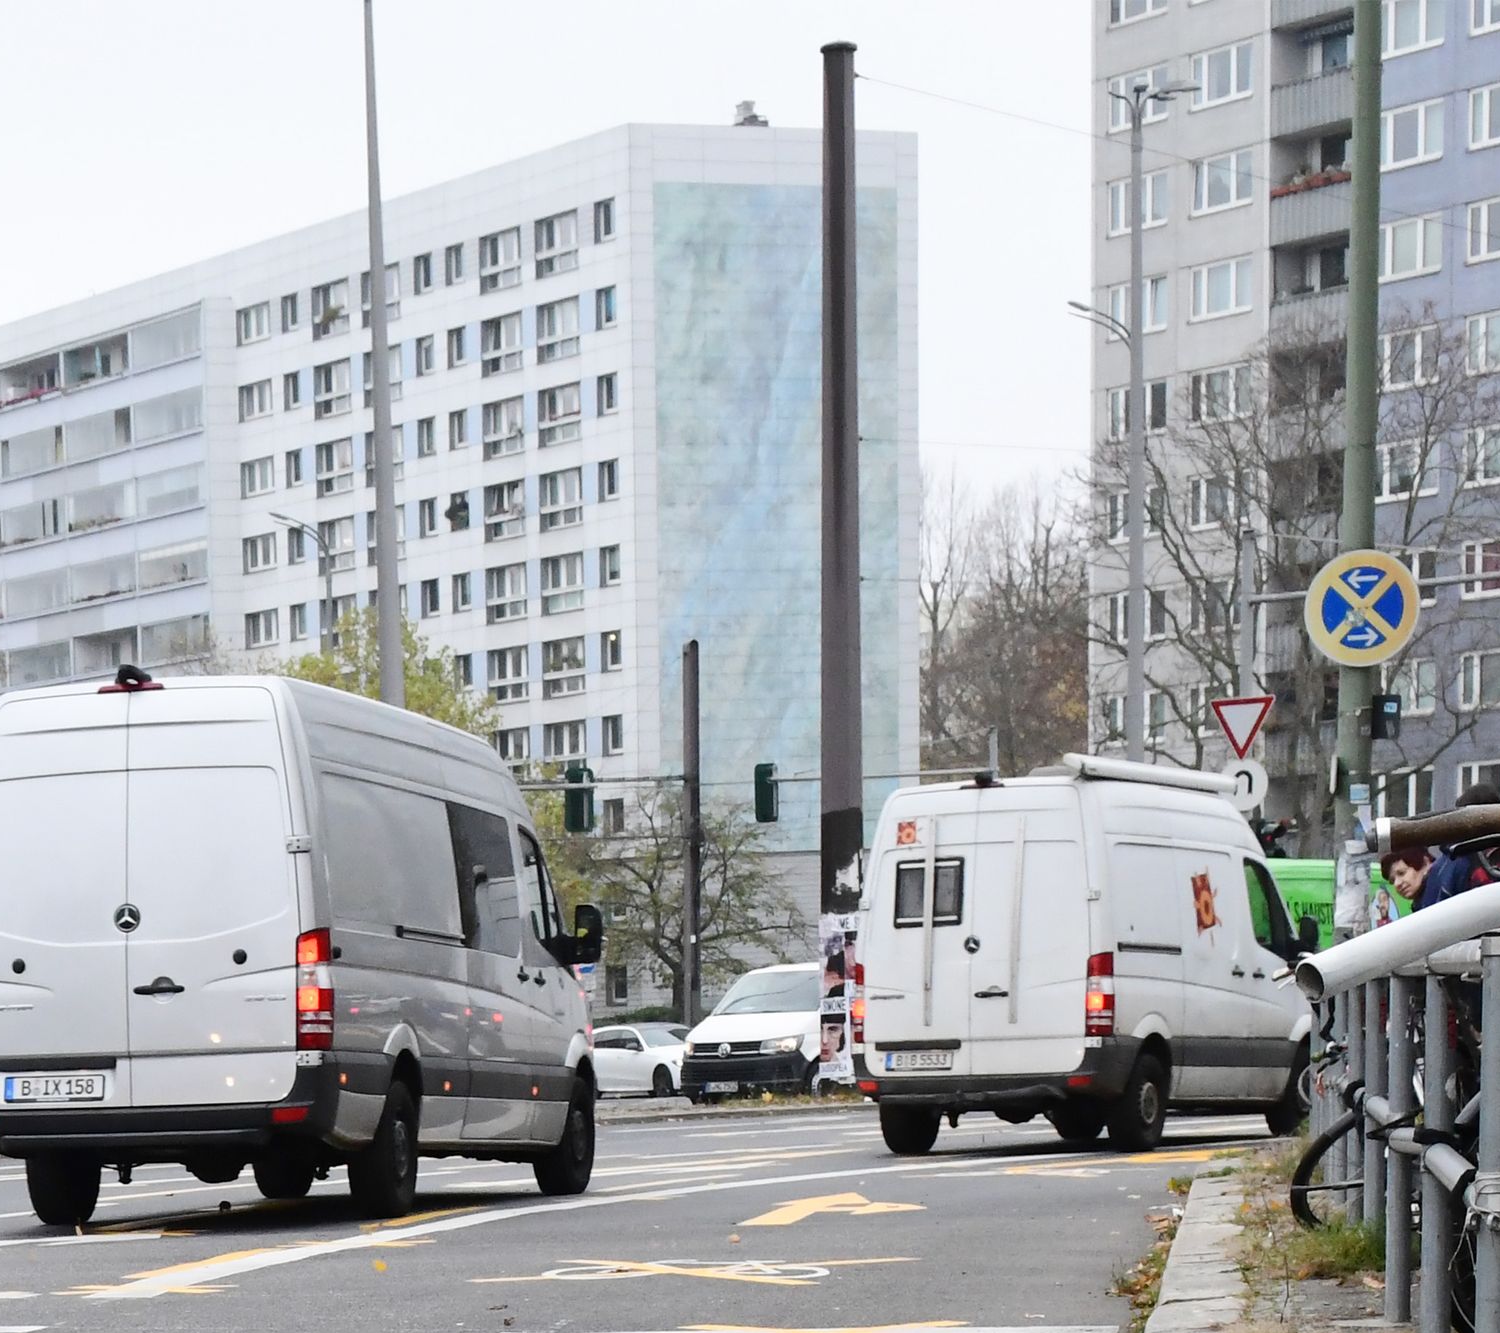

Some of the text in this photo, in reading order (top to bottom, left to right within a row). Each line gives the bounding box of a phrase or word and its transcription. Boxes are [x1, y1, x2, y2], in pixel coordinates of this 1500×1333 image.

[896, 1055, 904, 1067] B
[919, 1053, 948, 1066] 5533
[21, 1078, 95, 1096] B IX 158
